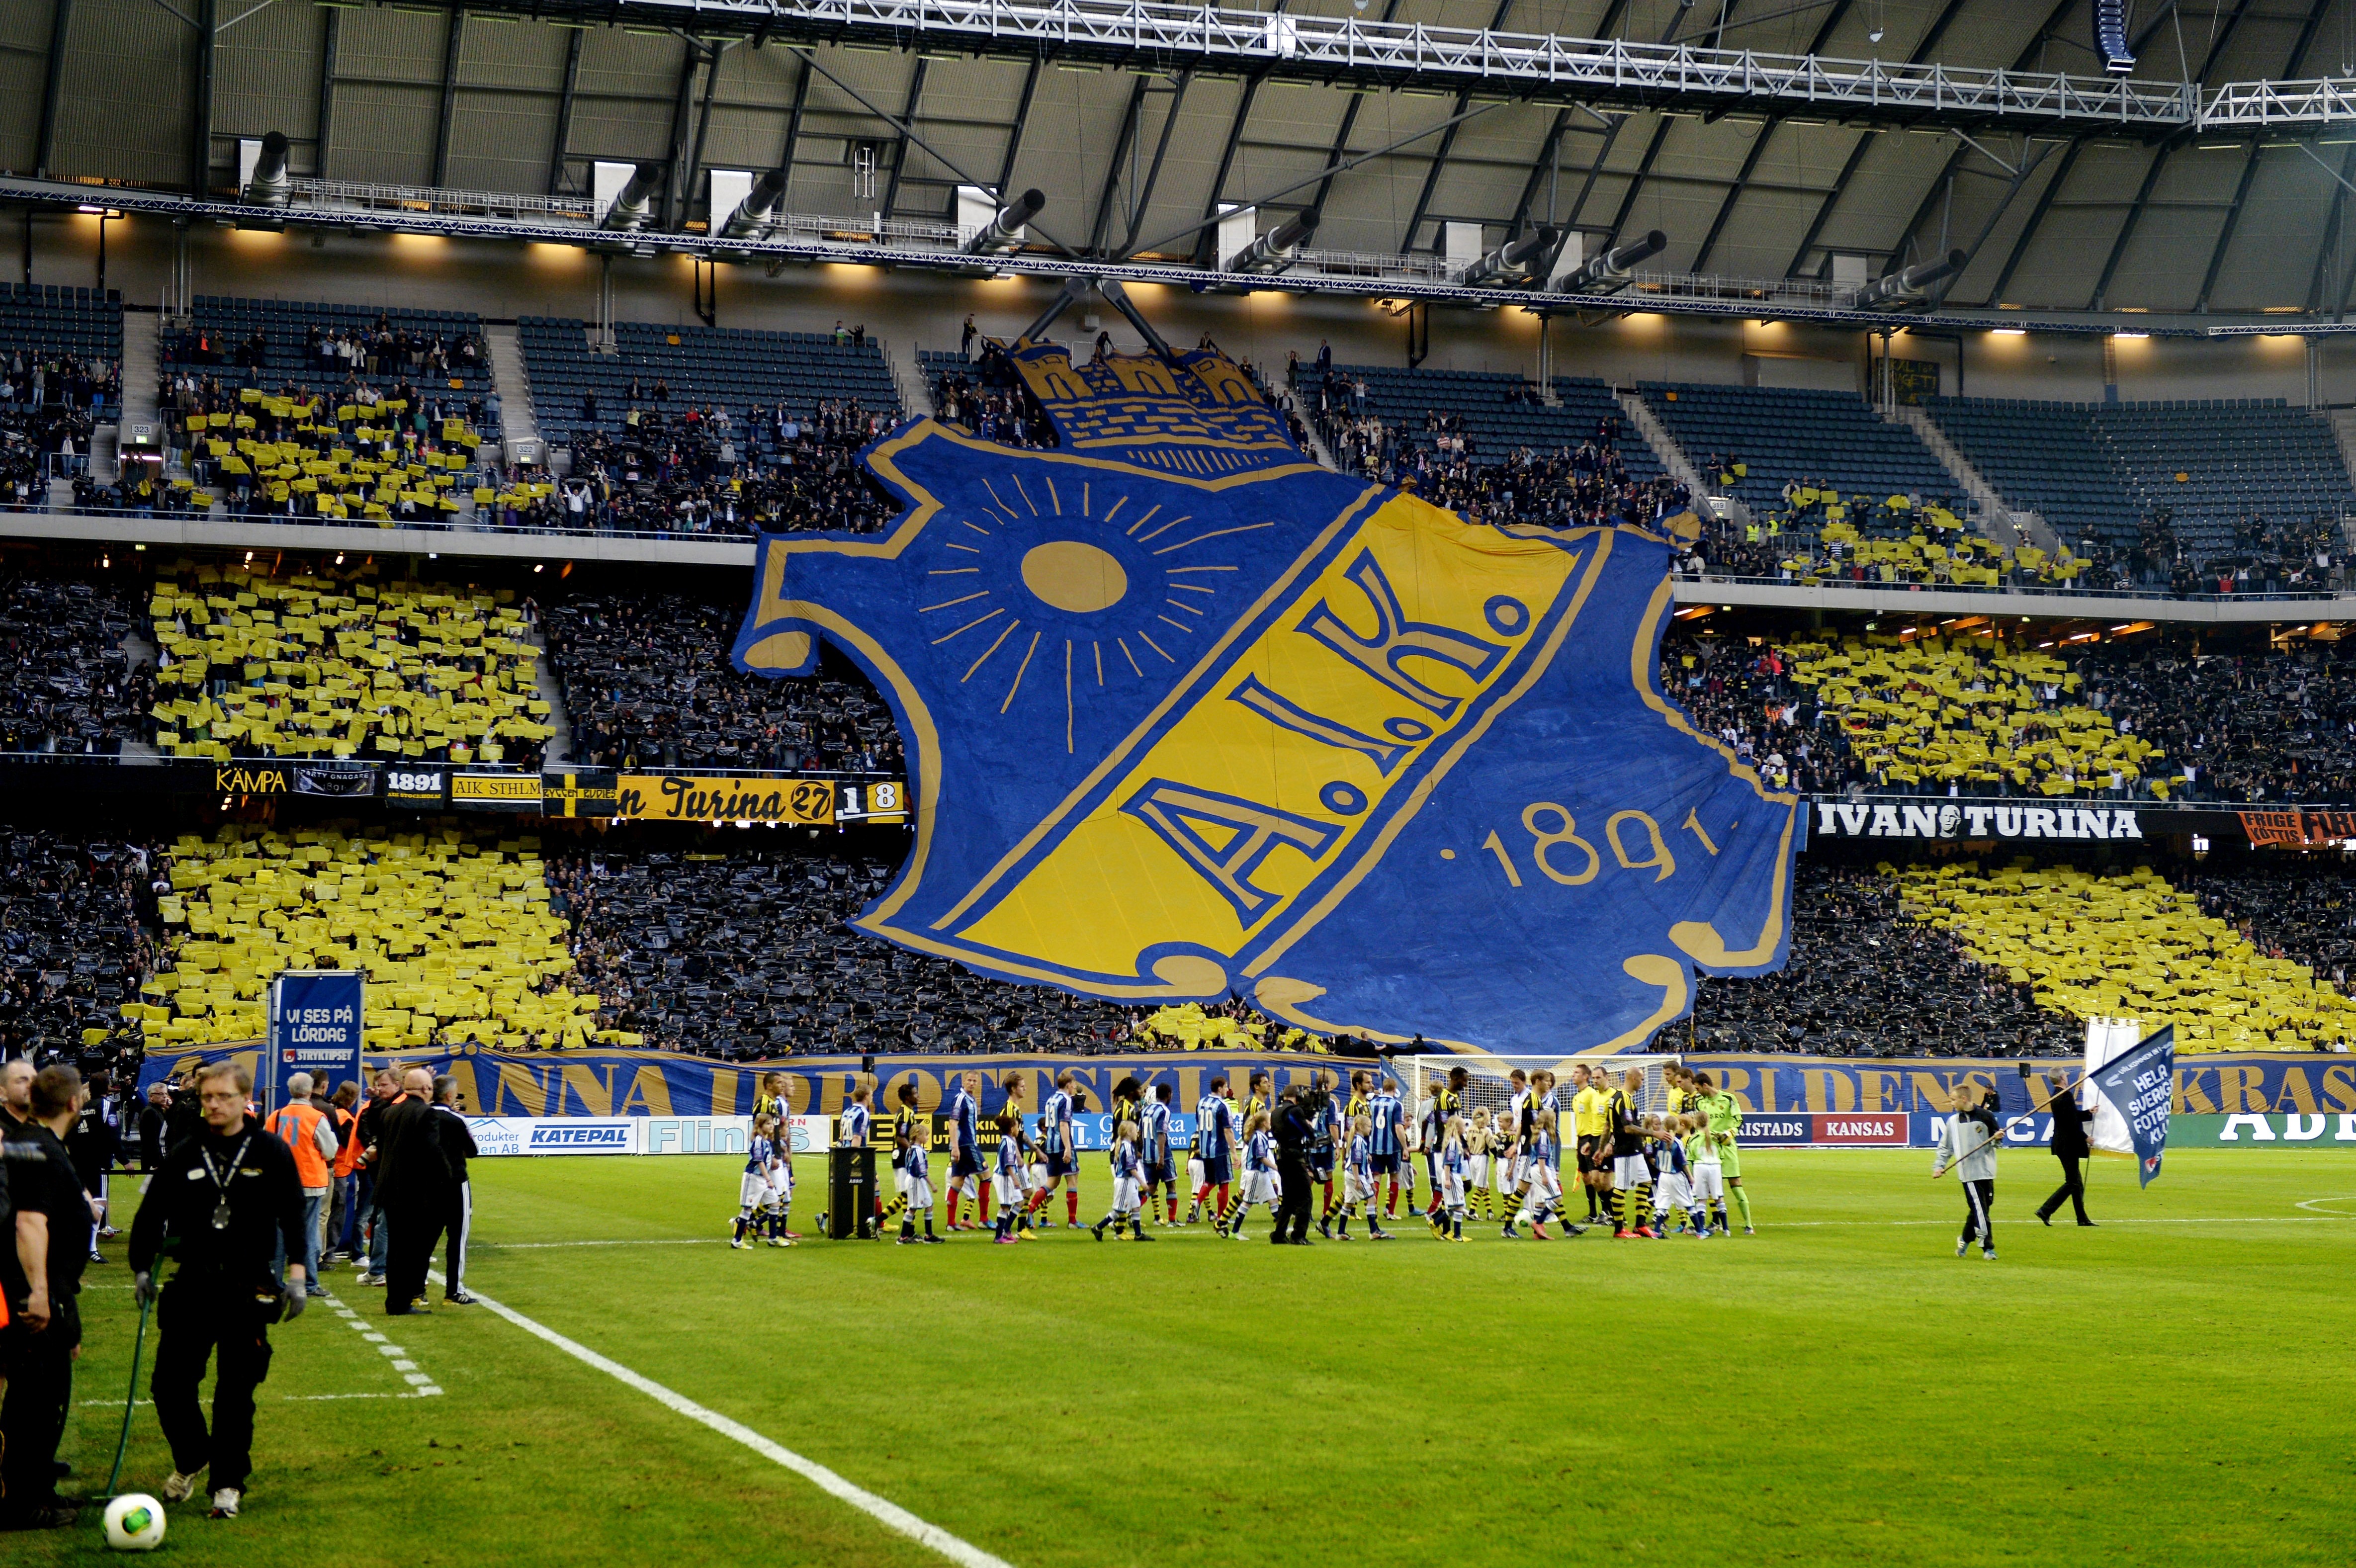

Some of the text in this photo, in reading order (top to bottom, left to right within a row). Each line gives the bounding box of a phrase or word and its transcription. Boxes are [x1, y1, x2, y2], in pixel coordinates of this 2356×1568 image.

[216, 768, 286, 792] KÄMPA
[300, 770, 327, 779] PARTY
[388, 772, 441, 791] 1891
[455, 781, 541, 795] AIK STHLM
[584, 789, 616, 799] RUDIES
[661, 777, 786, 820] Turina
[794, 785, 830, 819] 27
[1818, 803, 2142, 839] IVAN TURINA
[2244, 813, 2356, 840] FRIGE FIR
[1482, 801, 1720, 887] 1891
[2251, 826, 2300, 843] KÖTTIS
[286, 1005, 353, 1023] VI SES PÅ
[291, 1024, 347, 1042] LÖRDAG
[297, 1049, 354, 1061] STRYKTIPSET
[2118, 1051, 2153, 1075] VÄLKOMMEN
[2132, 1064, 2168, 1093] HELA
[1045, 1103, 1055, 1128] 13
[1199, 1109, 1213, 1132] 10
[1376, 1108, 1386, 1129] 6
[472, 1132, 519, 1141] rodukter
[531, 1130, 627, 1142] KATEPAL
[649, 1121, 810, 1153] Flins
[1142, 1116, 1153, 1139] 11
[1735, 1122, 1803, 1136] RISTADS
[1826, 1122, 1894, 1136] KANSAS
[502, 1144, 519, 1153] AB
